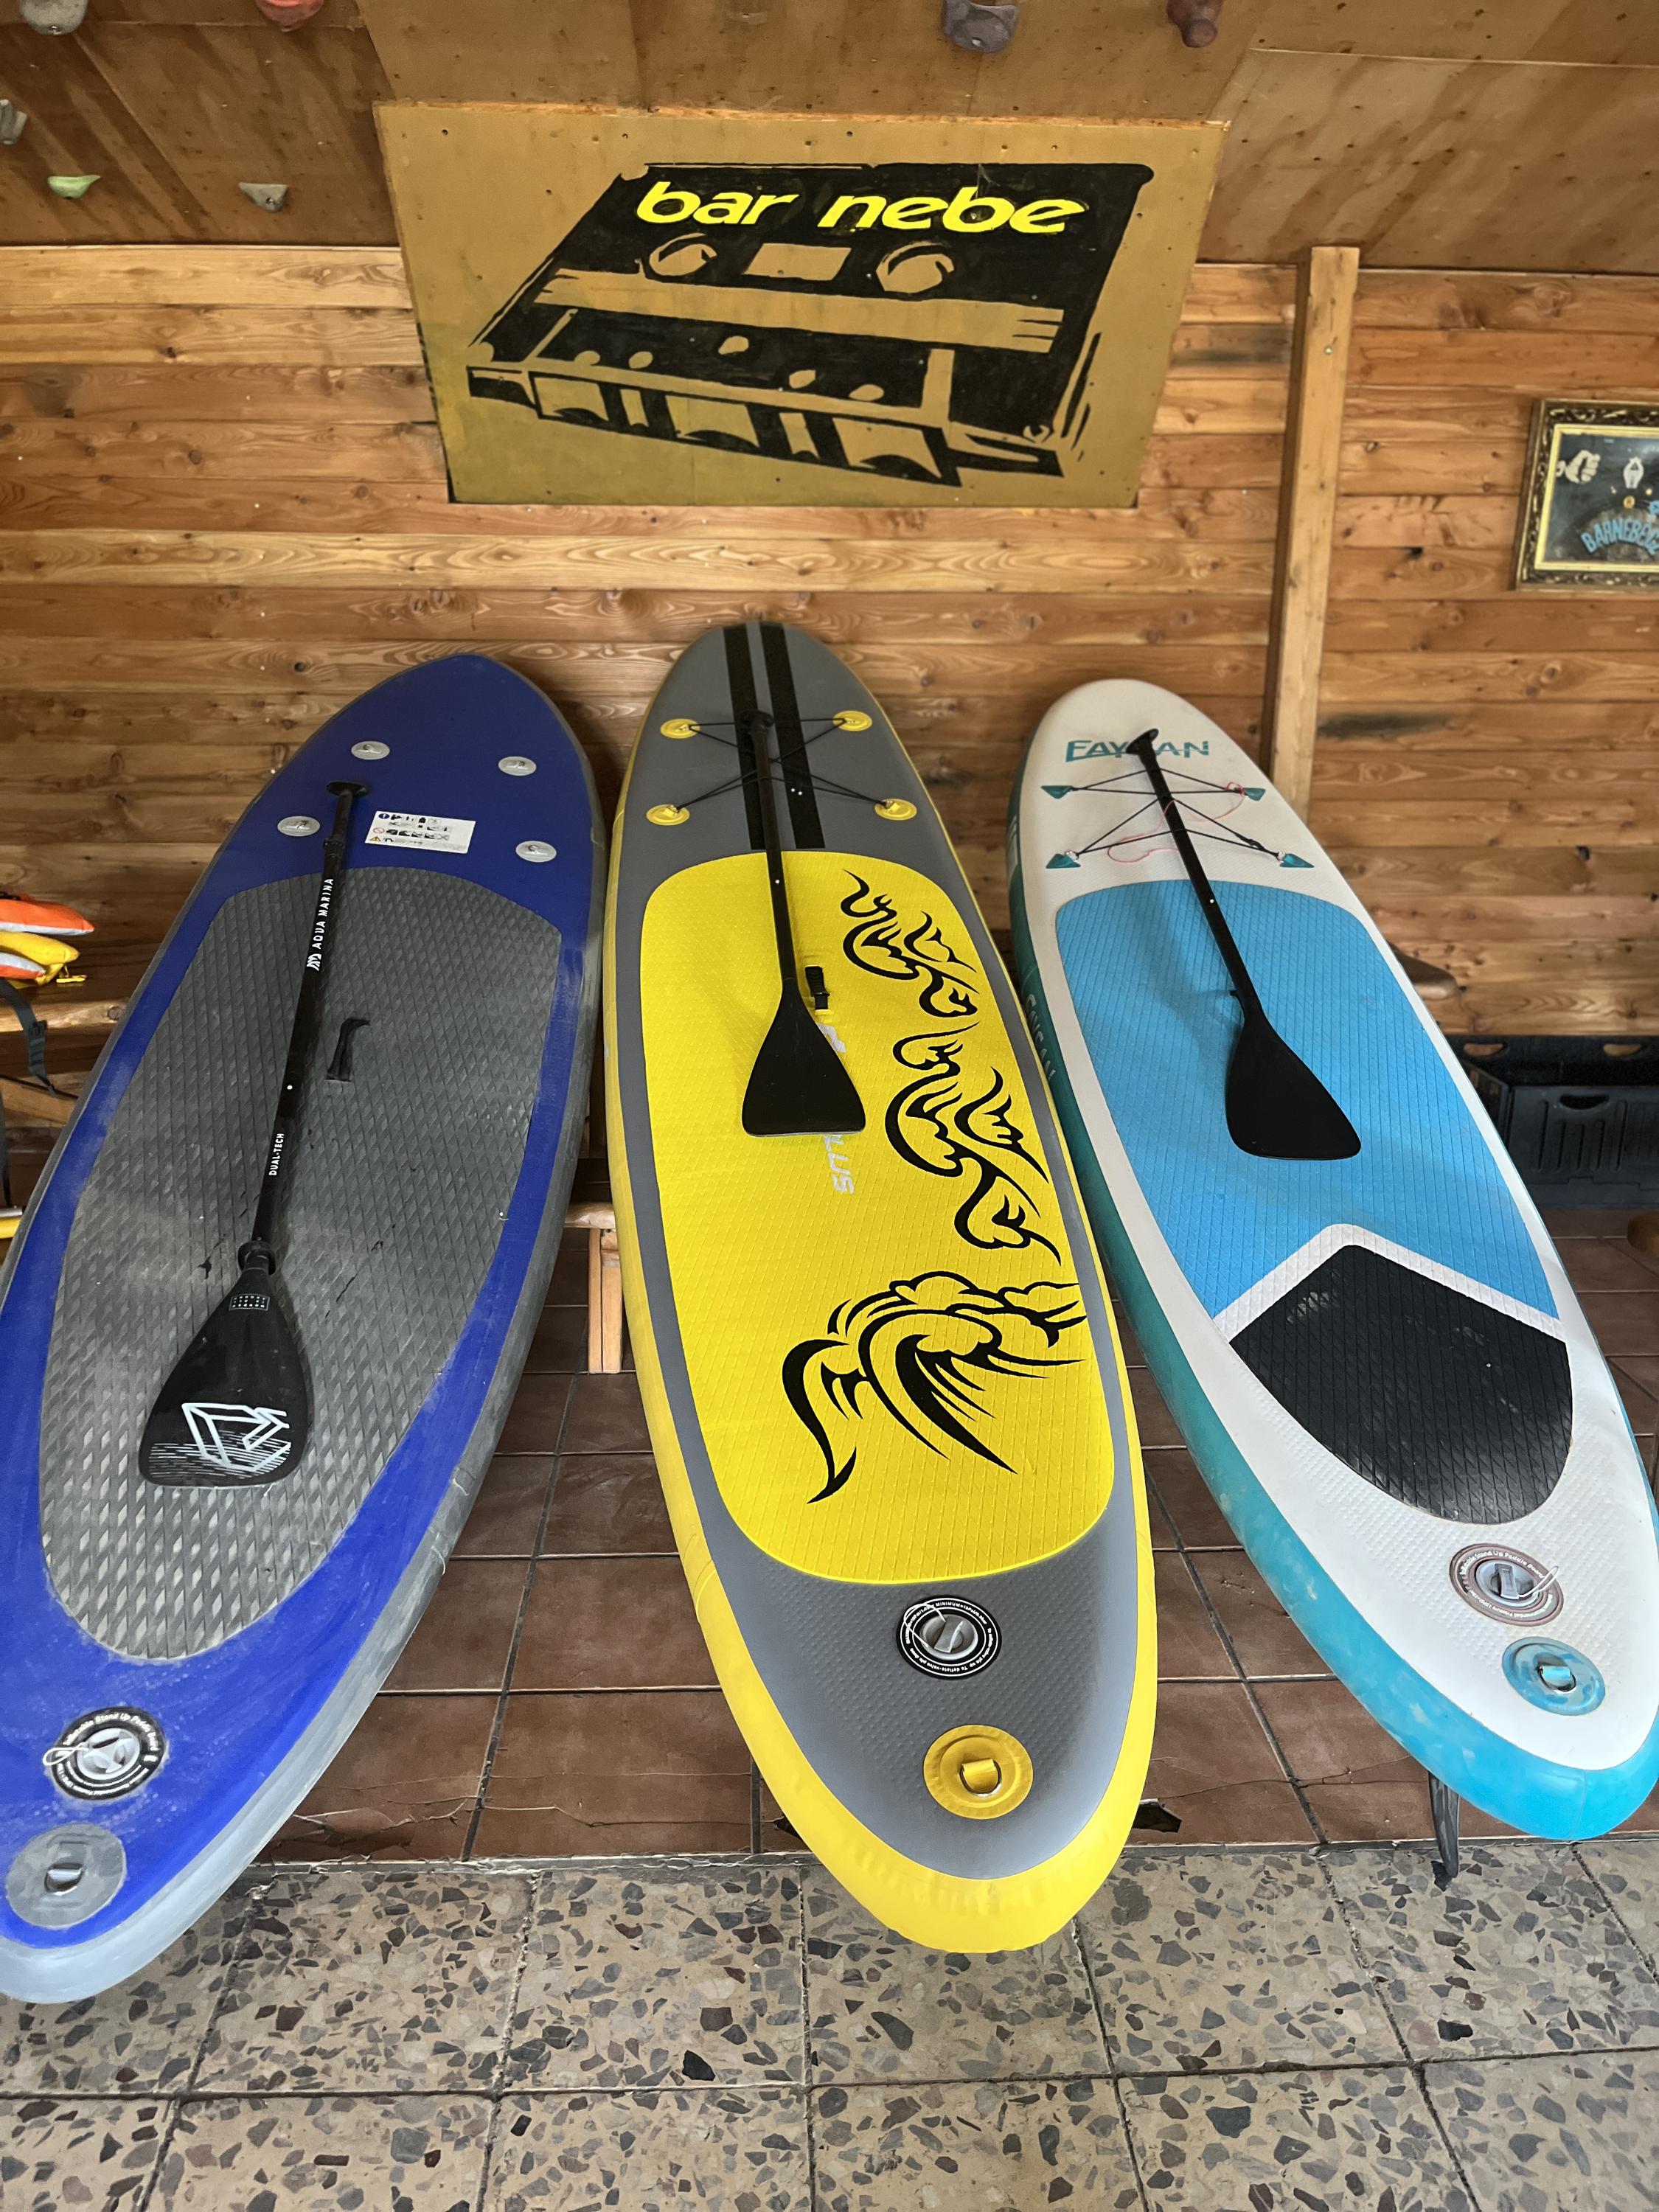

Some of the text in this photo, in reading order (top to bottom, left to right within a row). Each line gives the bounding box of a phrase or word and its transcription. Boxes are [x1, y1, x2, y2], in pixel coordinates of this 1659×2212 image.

[636, 181, 1086, 233] bar nebe
[1065, 740, 1209, 762] FAYAN
[312, 879, 334, 950] AQUA MARINA
[824, 1133, 855, 1194] LUS
